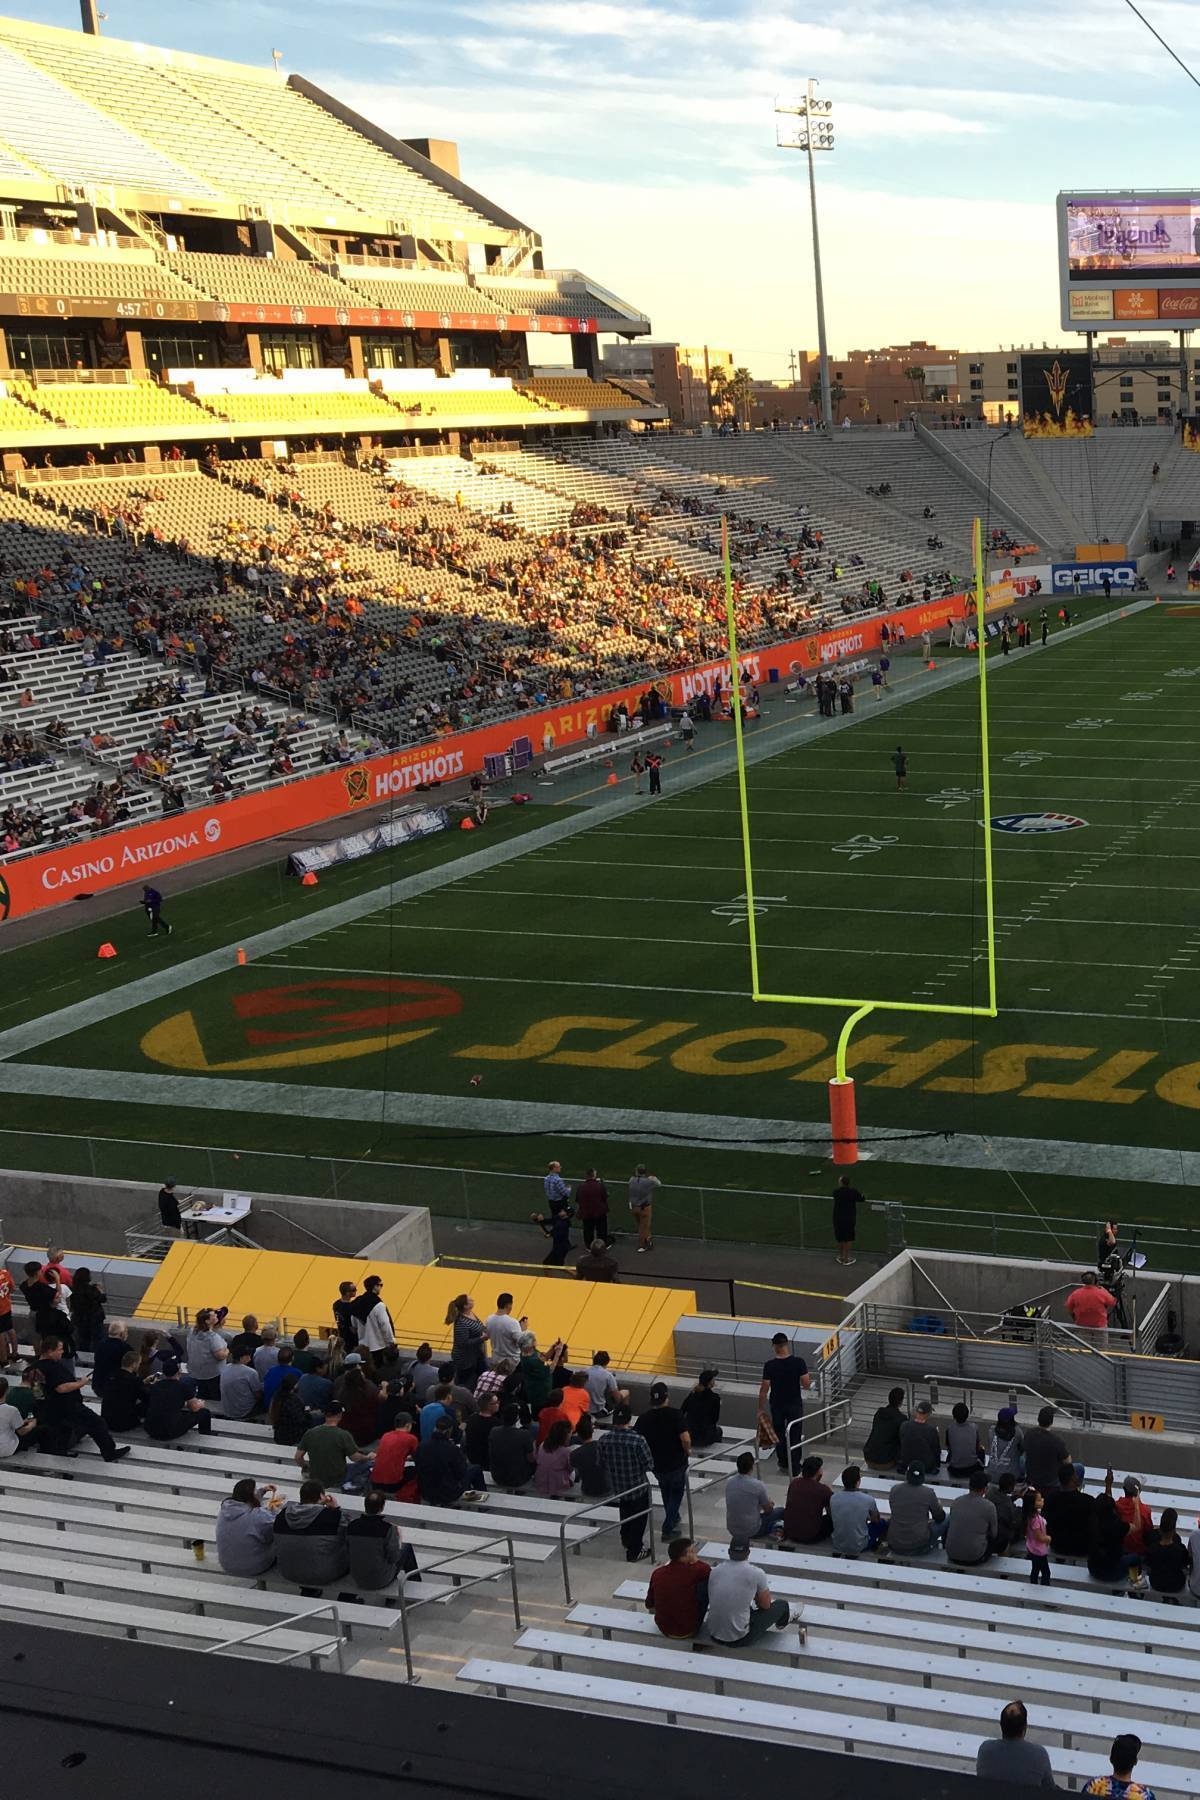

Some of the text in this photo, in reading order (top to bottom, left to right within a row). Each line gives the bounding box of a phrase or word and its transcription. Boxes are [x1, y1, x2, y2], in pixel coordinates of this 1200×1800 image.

[57, 300, 65, 313] 0
[116, 302, 141, 316] 4:57
[156, 302, 164, 317] 0
[1161, 296, 1199, 311] Coca-Cola
[1054, 567, 1134, 587] GEICO
[820, 634, 863, 660] HOTSHOTS
[543, 693, 645, 736] ARIZO
[392, 746, 444, 766] ARIZONA
[375, 751, 464, 797] HOTSHOTS
[831, 834, 900, 854] 20
[41, 832, 200, 890] CASINO ARIZONA
[711, 893, 788, 917] 10
[1140, 1415, 1156, 1430] 17
